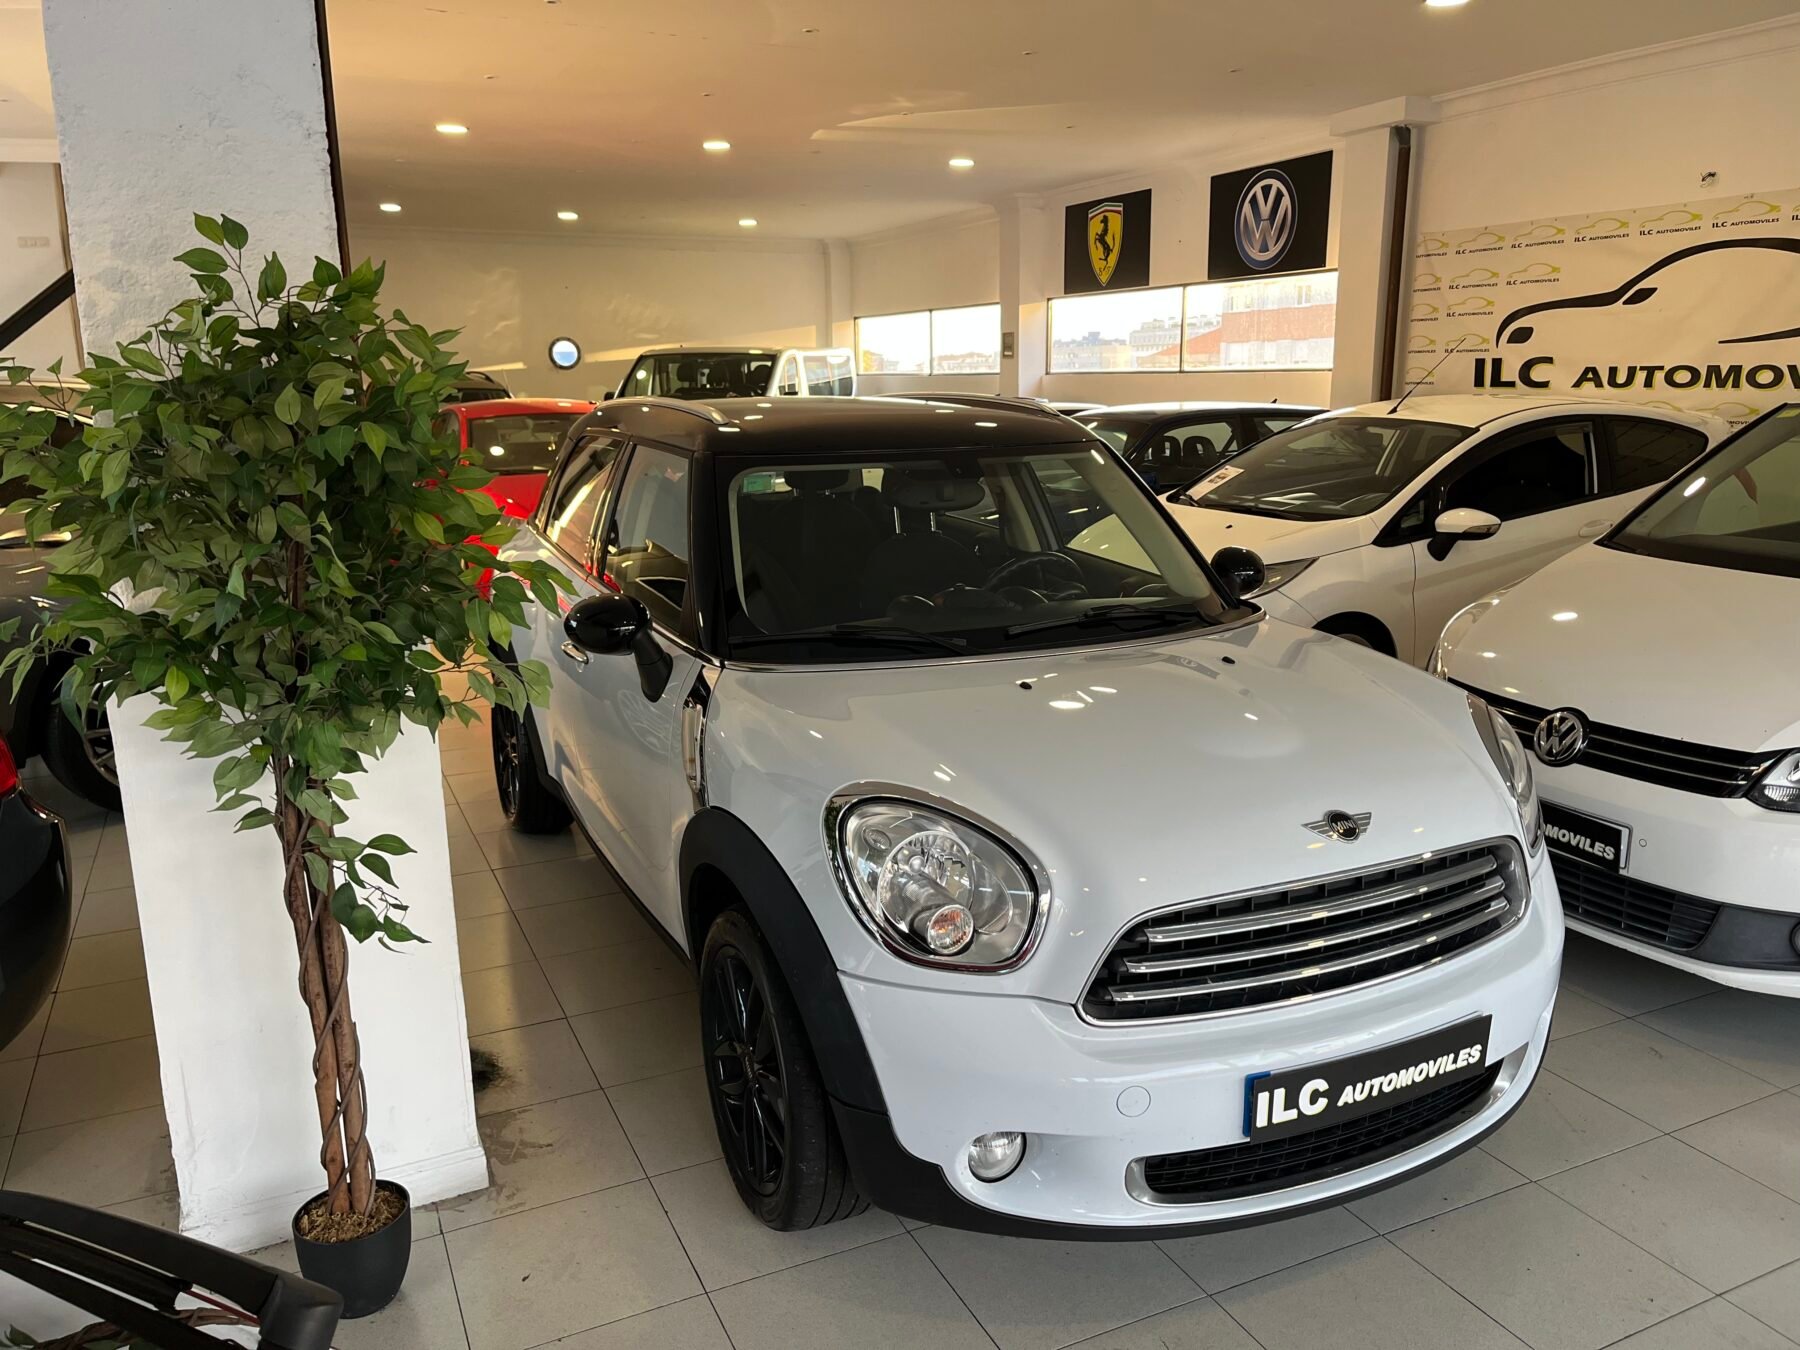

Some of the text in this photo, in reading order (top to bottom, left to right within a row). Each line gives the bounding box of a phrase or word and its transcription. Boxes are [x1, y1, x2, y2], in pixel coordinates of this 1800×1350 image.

[1711, 217, 1780, 229] ILC AUTOMOVILES
[1655, 226, 1702, 235] AUTOMOVILES
[1588, 233, 1630, 241] AUTOMOVILES
[1524, 239, 1565, 248] AUTOMOVILES
[1467, 246, 1504, 254] AUTOMOVILES
[1473, 356, 1553, 389] ILC
[1331, 819, 1357, 832] MINI
[1543, 822, 1616, 861] MOVILES
[1255, 1044, 1483, 1129] ILC AUTOMOVILES
